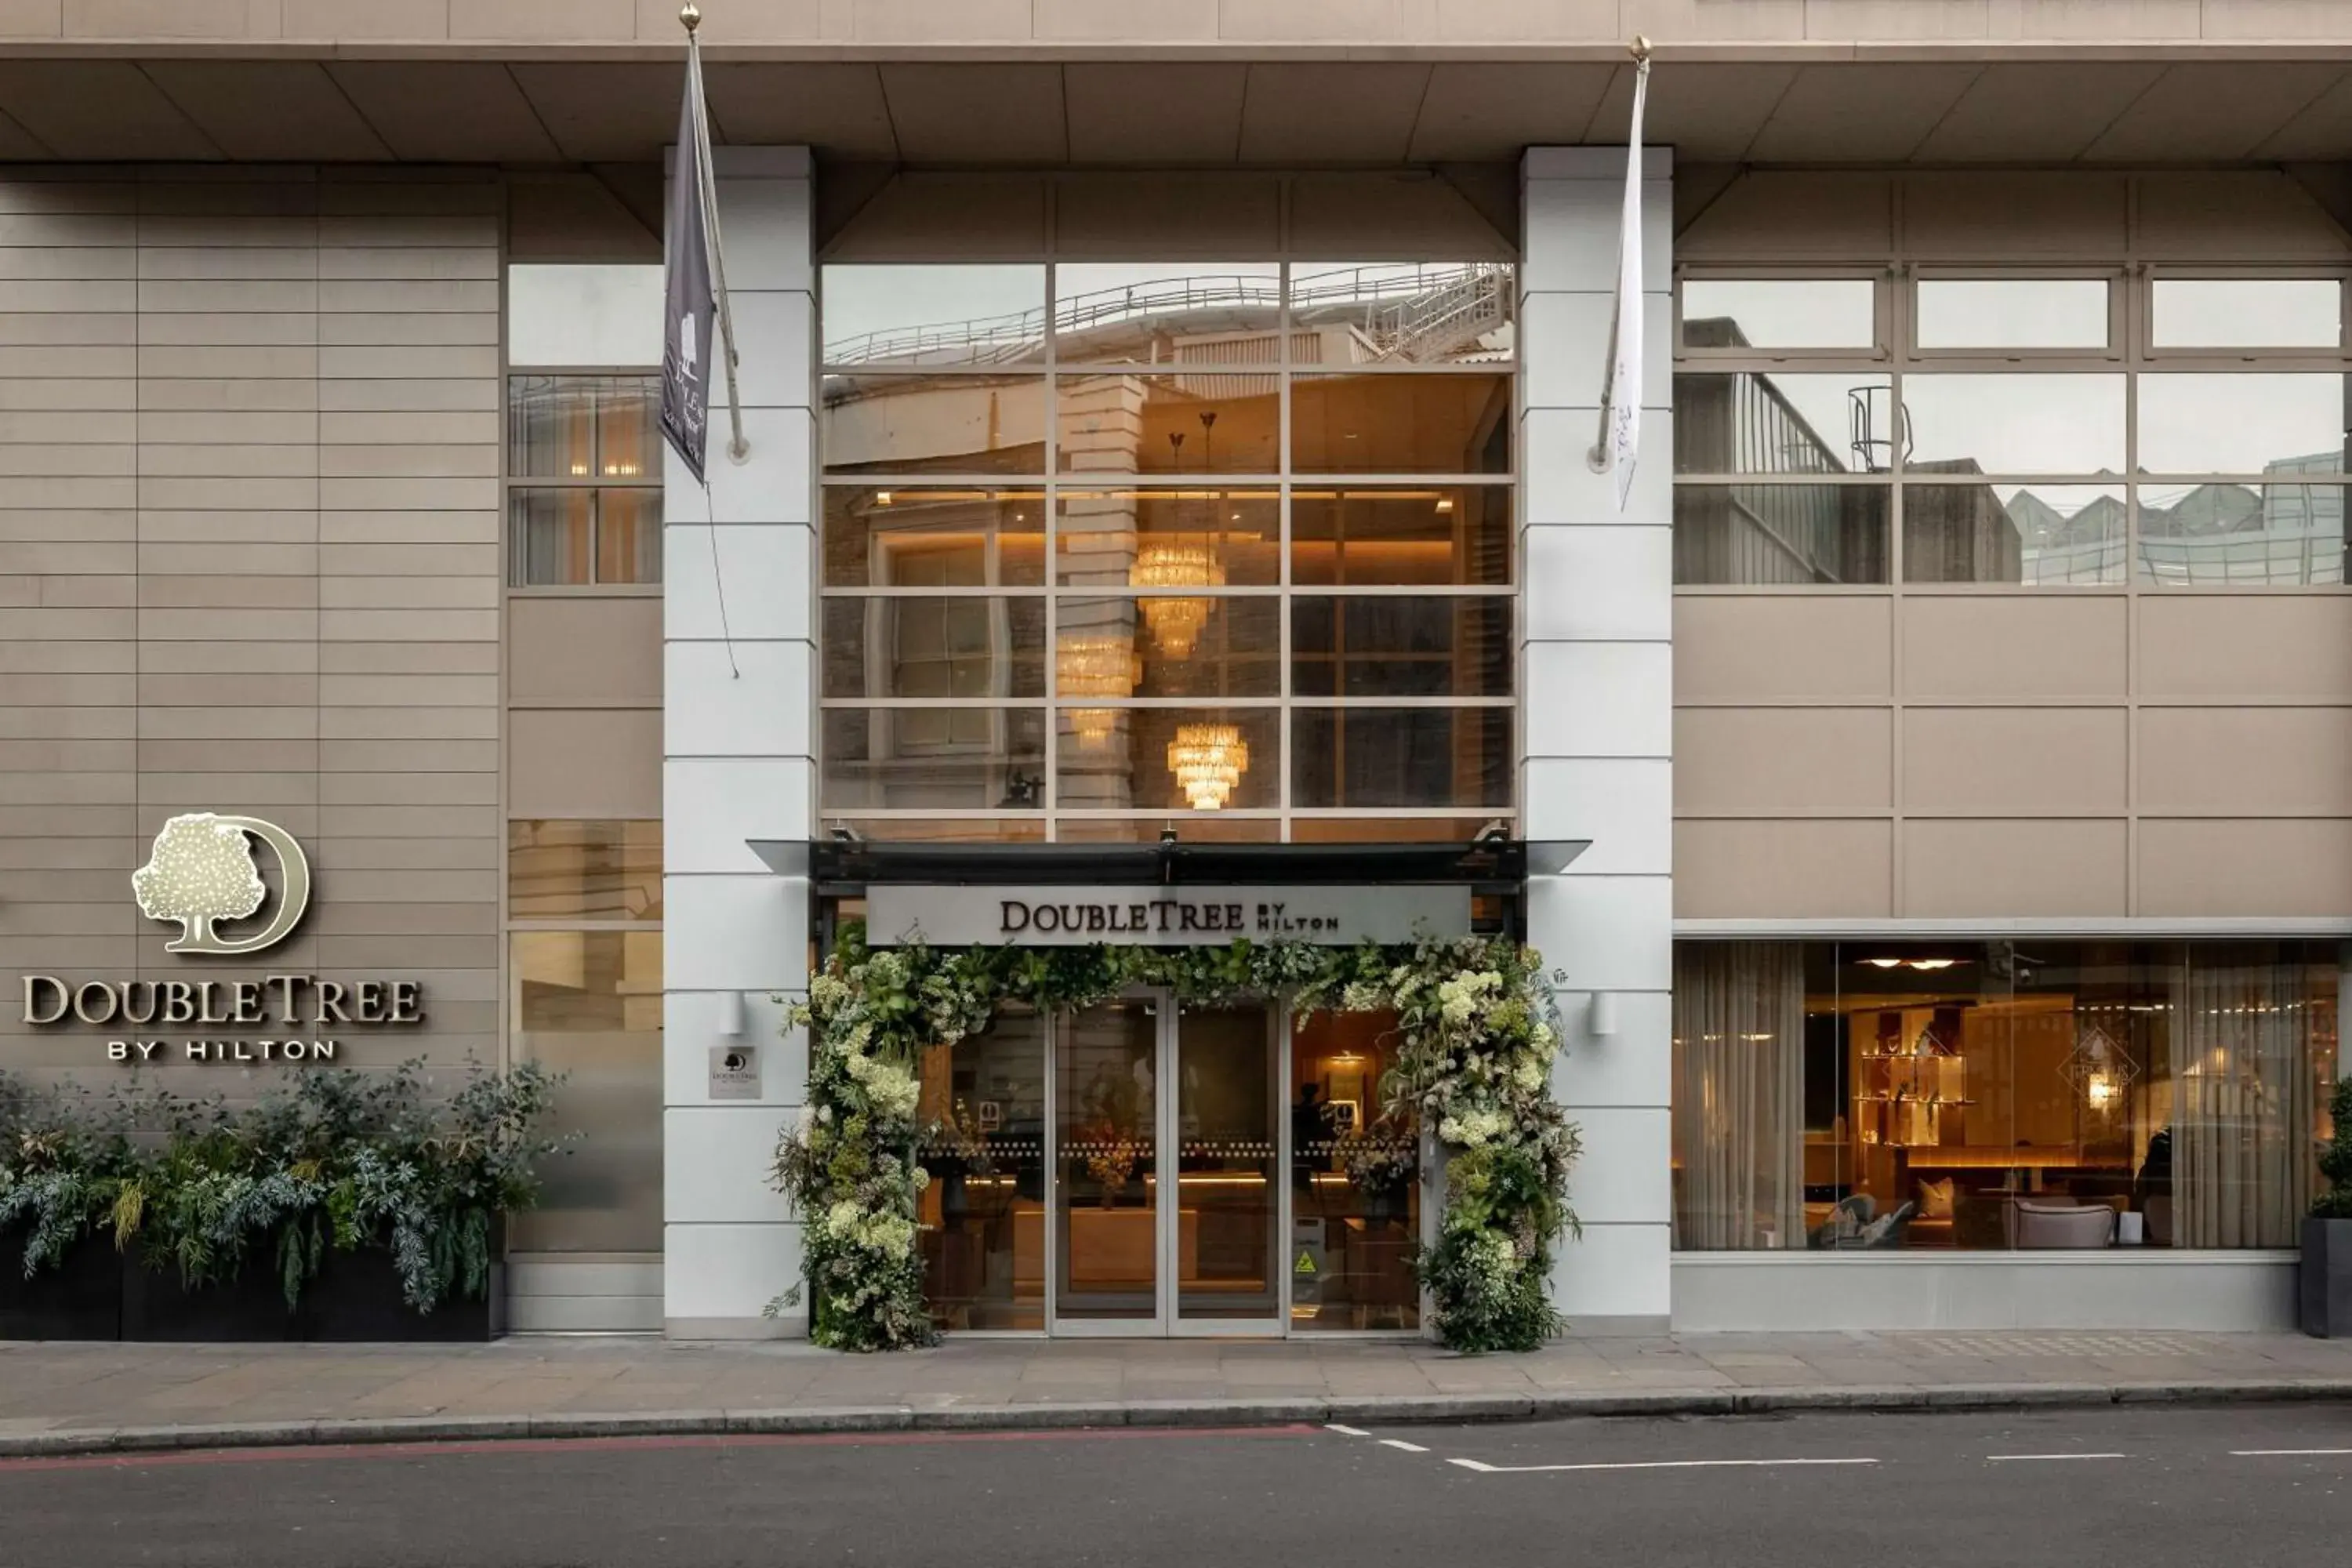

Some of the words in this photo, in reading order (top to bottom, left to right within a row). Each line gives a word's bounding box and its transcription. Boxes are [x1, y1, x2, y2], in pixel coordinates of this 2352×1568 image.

[1000, 901, 1245, 931] DOUBLETREE
[1257, 903, 1286, 916] BY
[1257, 917, 1339, 931] HILTON
[22, 975, 423, 1023] DOUBLETREE
[108, 1040, 157, 1060] BY
[186, 1040, 335, 1060] HILTON
